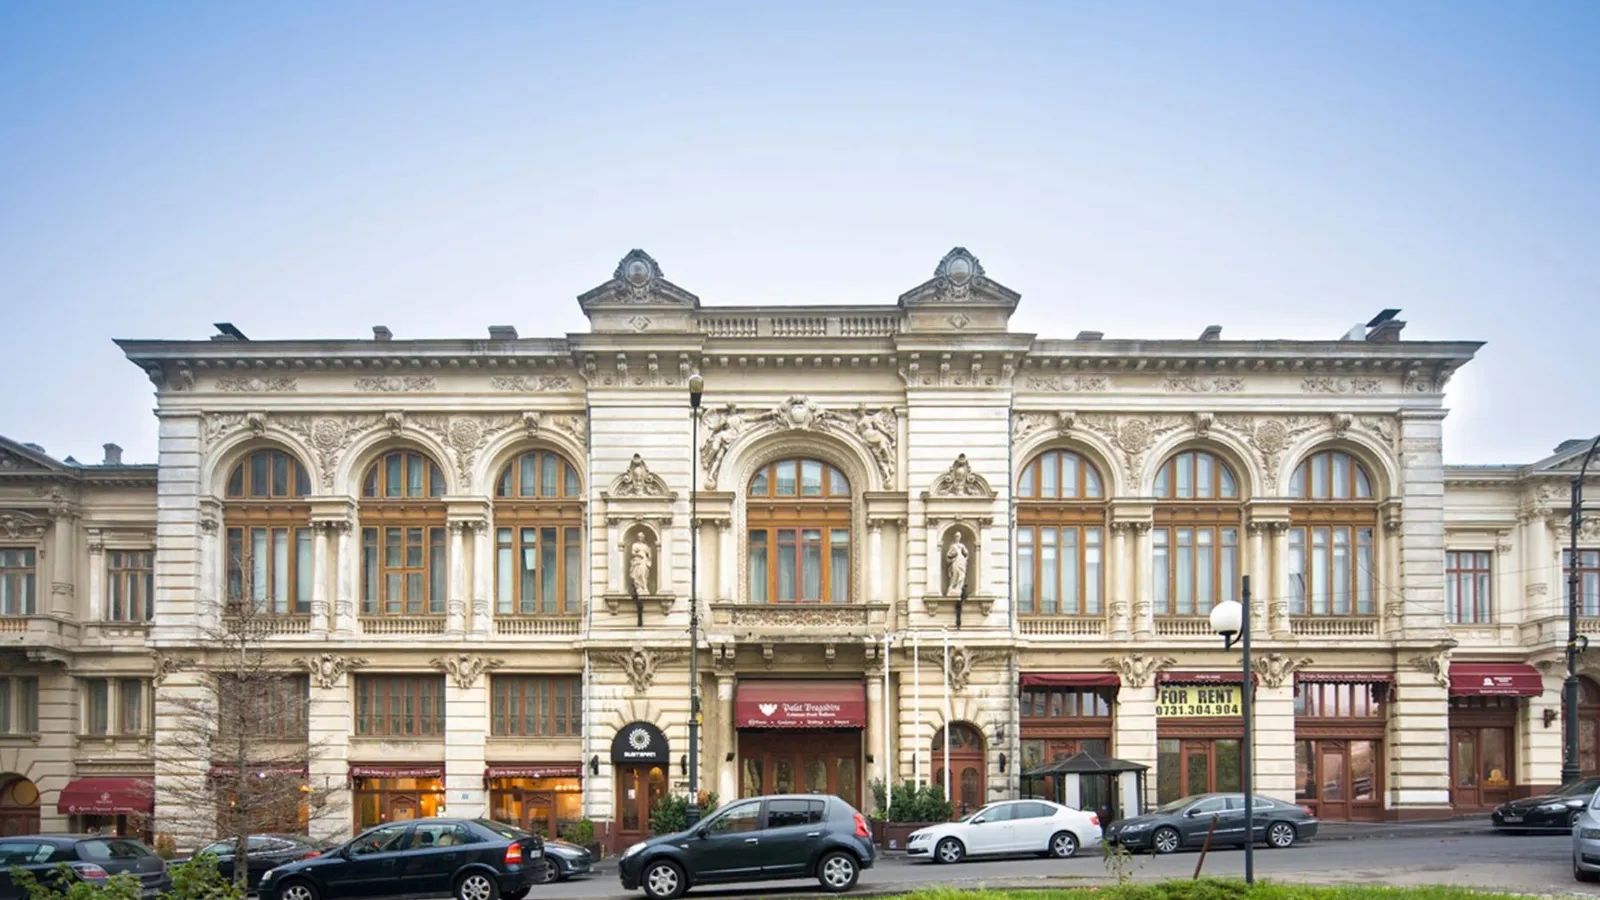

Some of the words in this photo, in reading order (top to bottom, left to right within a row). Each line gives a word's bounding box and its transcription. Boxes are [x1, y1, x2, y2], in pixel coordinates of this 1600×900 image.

[1161, 690, 1188, 704] FOR
[1198, 689, 1234, 704] RENT
[1156, 704, 1239, 716] 0731.304.904
